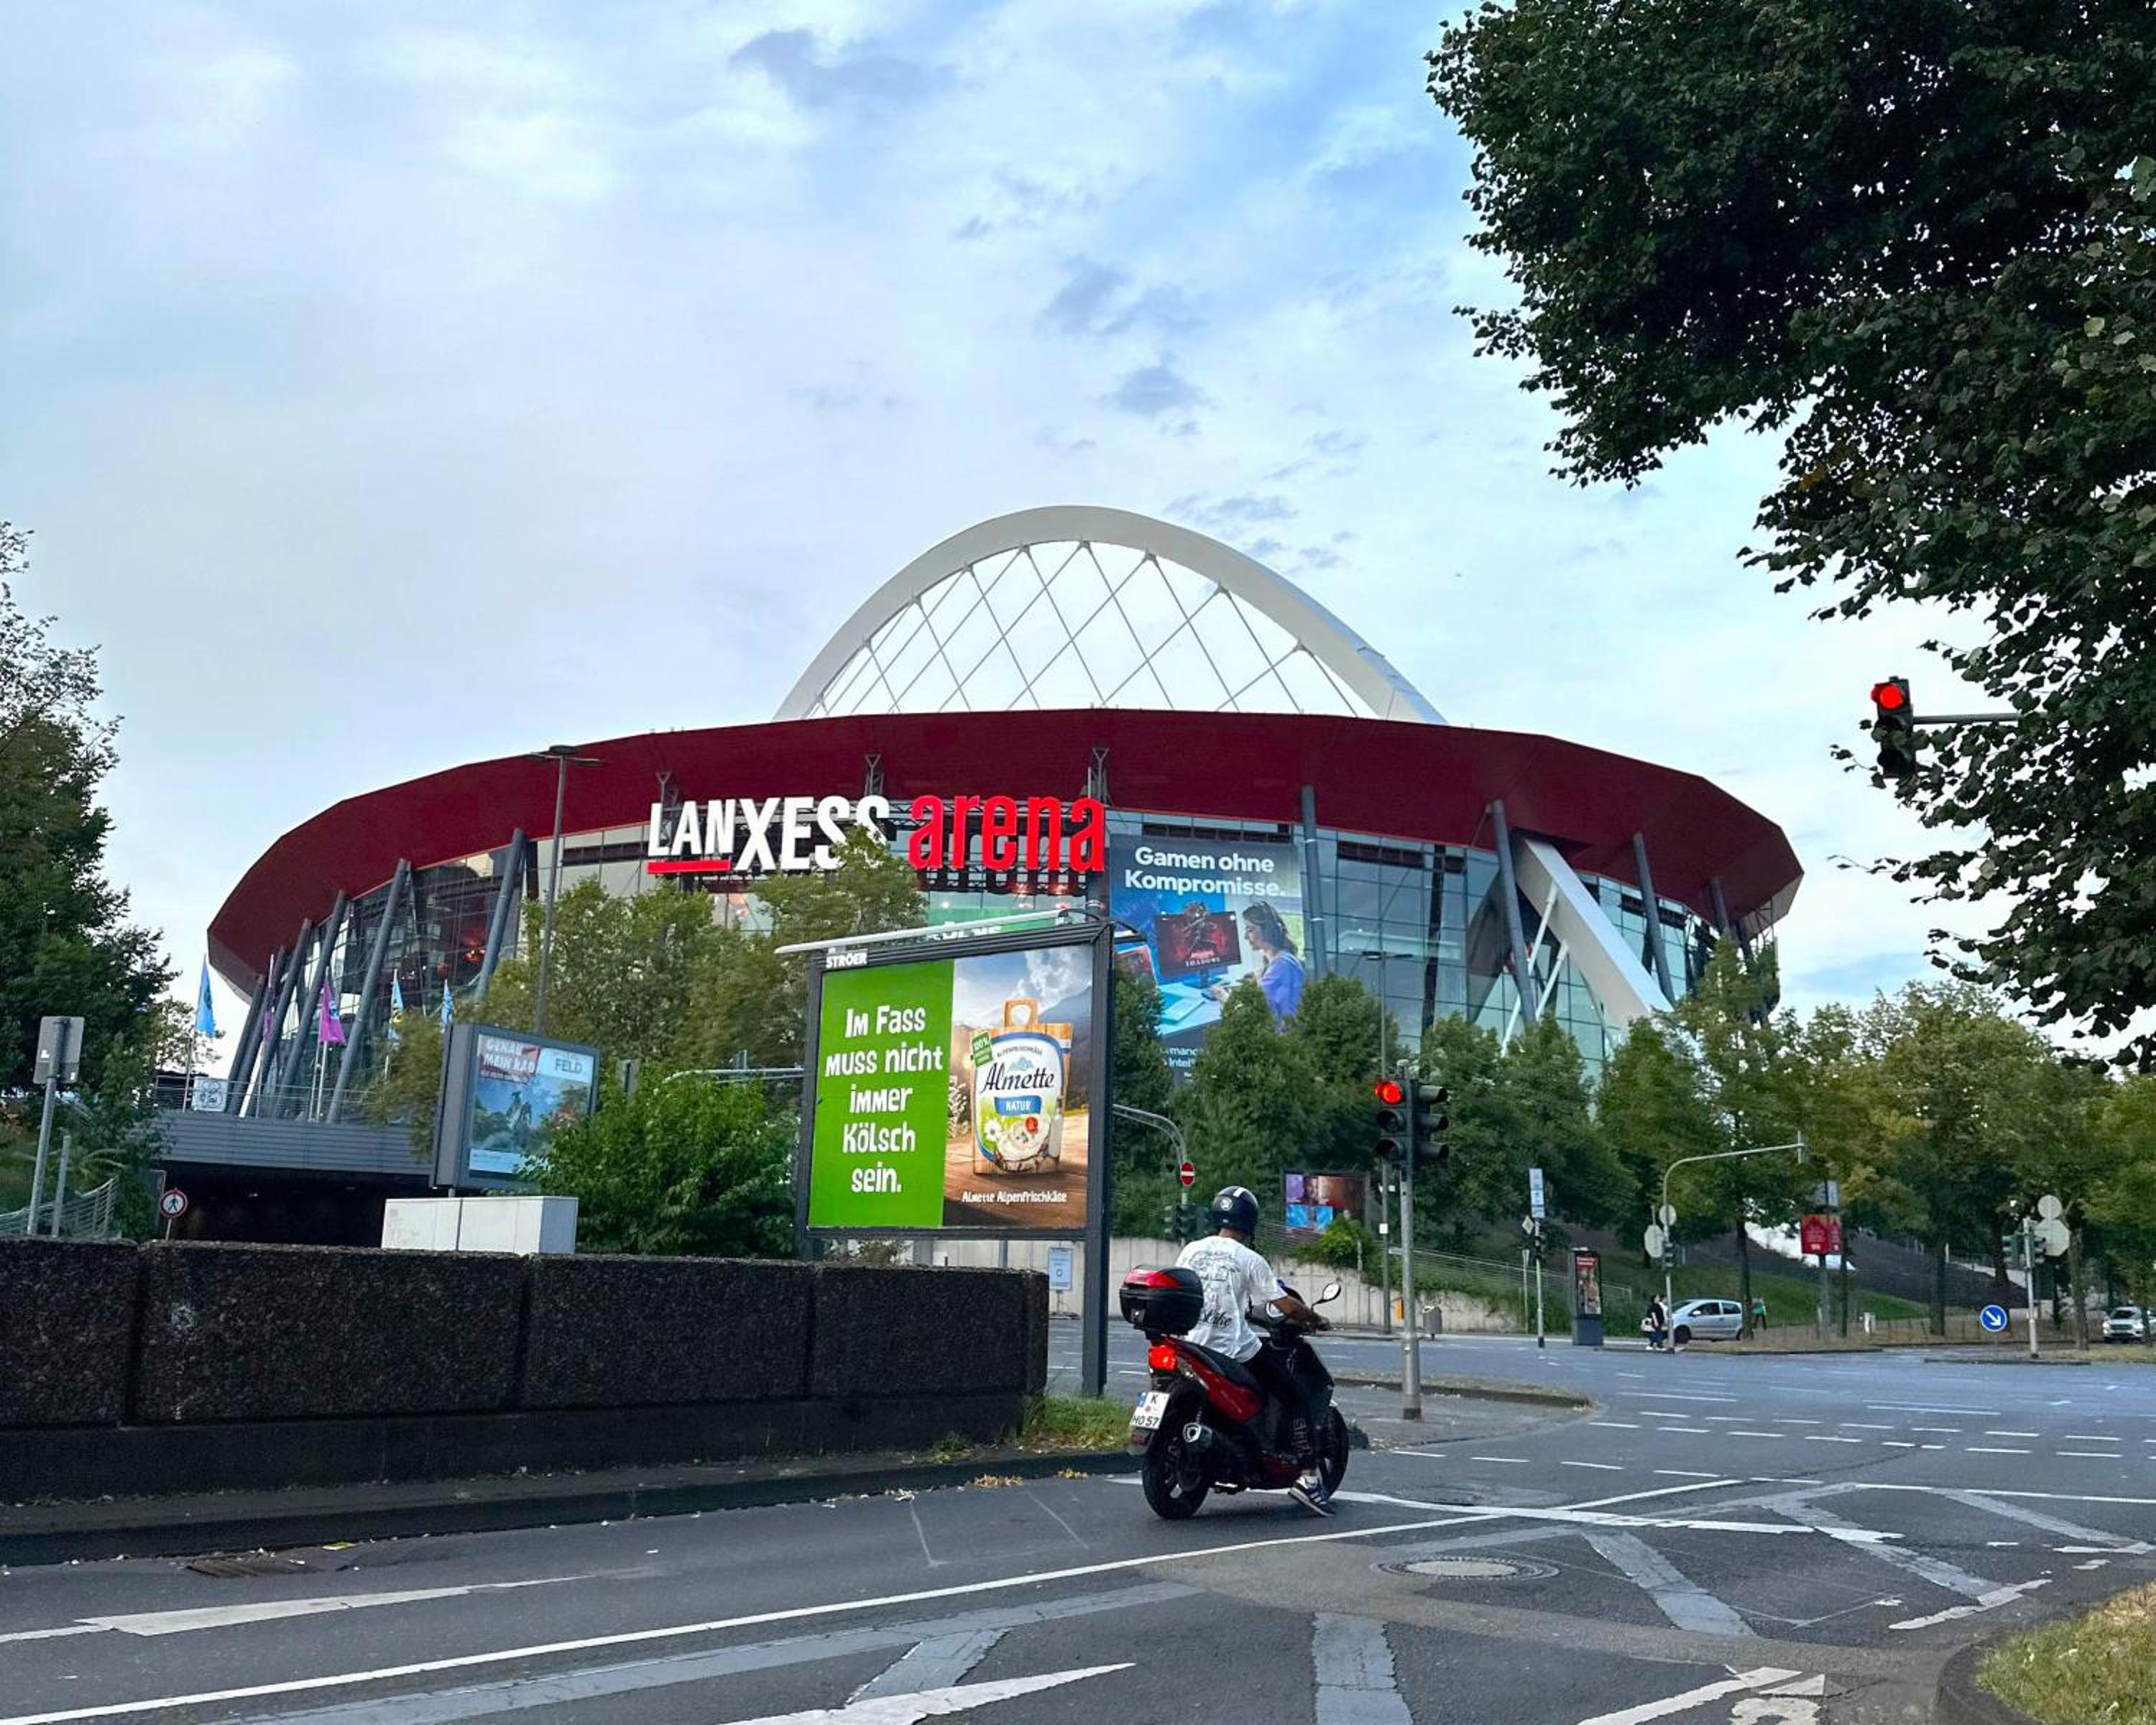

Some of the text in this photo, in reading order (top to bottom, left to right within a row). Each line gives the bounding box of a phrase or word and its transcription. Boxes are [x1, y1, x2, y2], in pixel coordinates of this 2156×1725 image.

[648, 795, 1105, 873] LANXESS arena
[1135, 847, 1274, 873] Gamen ohne
[1125, 870, 1286, 896] Kompromisse.
[845, 1005, 926, 1038] Im Fass
[555, 1058, 583, 1074] FELD
[885, 1041, 943, 1073] nicht
[980, 1062, 1055, 1094] Almette
[849, 1083, 913, 1113] immer
[1005, 1100, 1031, 1112] NATUR
[843, 1121, 916, 1154] Kölsch
[852, 1161, 902, 1193] sein.
[962, 1190, 995, 1202] Almette
[1151, 1394, 1158, 1404] K
